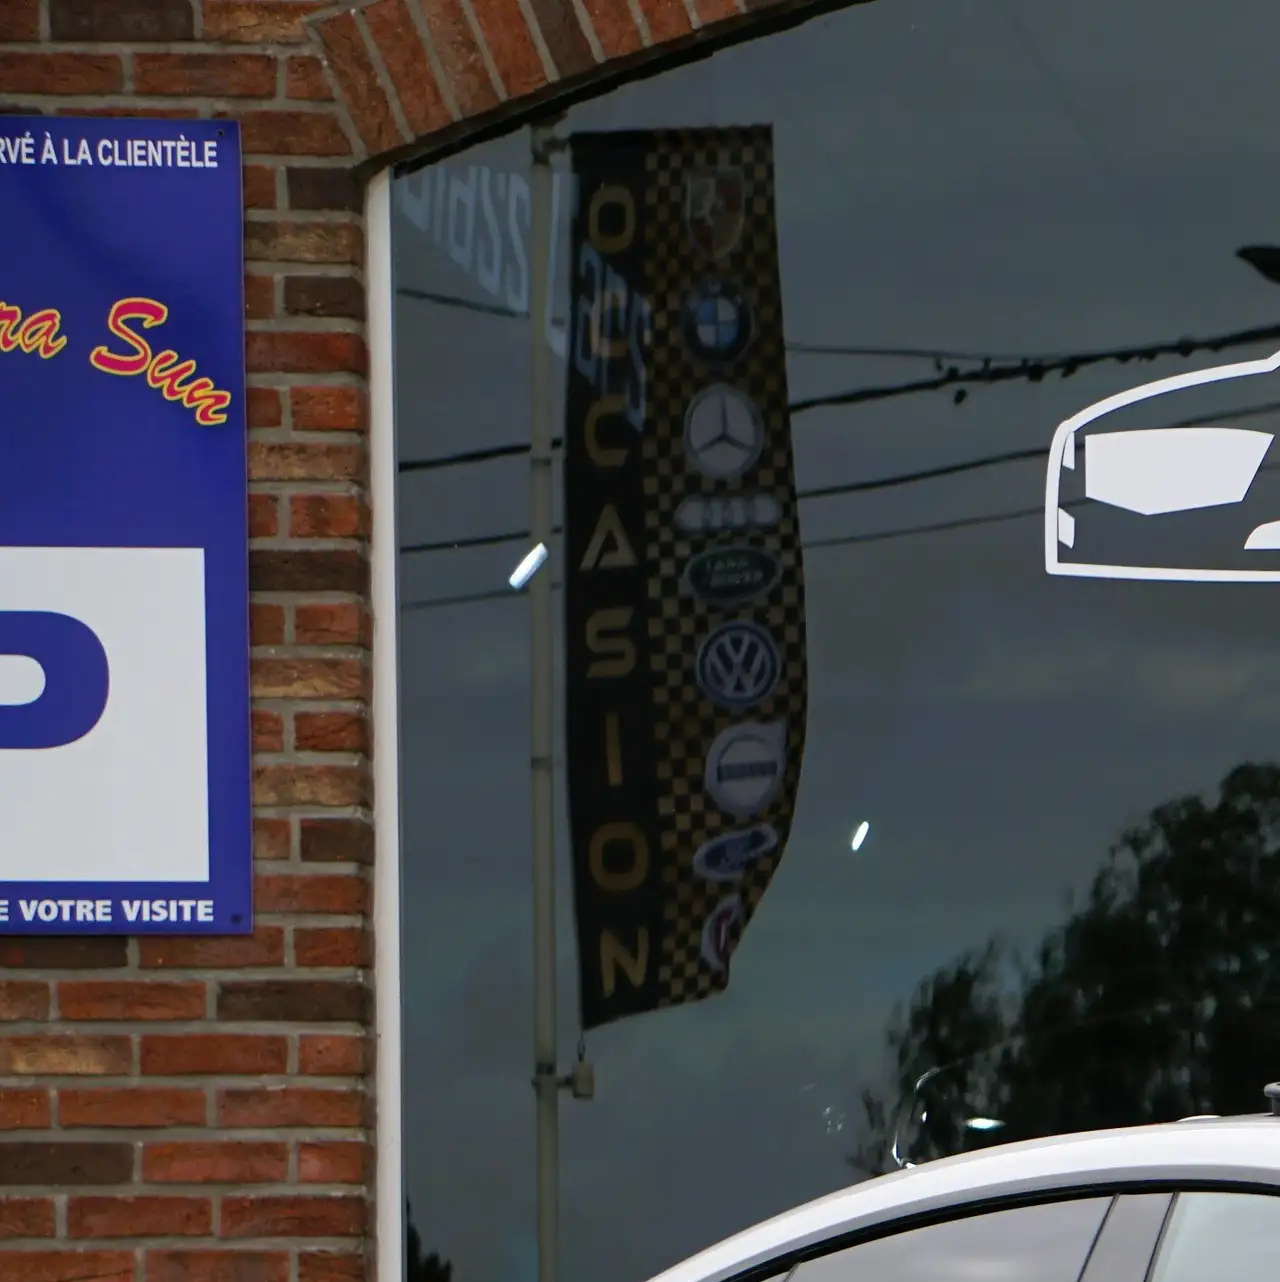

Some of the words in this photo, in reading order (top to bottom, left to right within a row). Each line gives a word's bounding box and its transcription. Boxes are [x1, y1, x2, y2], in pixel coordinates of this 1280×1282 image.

[41, 130, 58, 165] À
[63, 138, 93, 166] LA
[97, 134, 218, 168] CLIENTÈLE
[90, 297, 232, 426] Sun
[579, 185, 651, 998] OCCASION
[18, 899, 112, 922] VOTRE
[121, 899, 214, 922] VISITE
